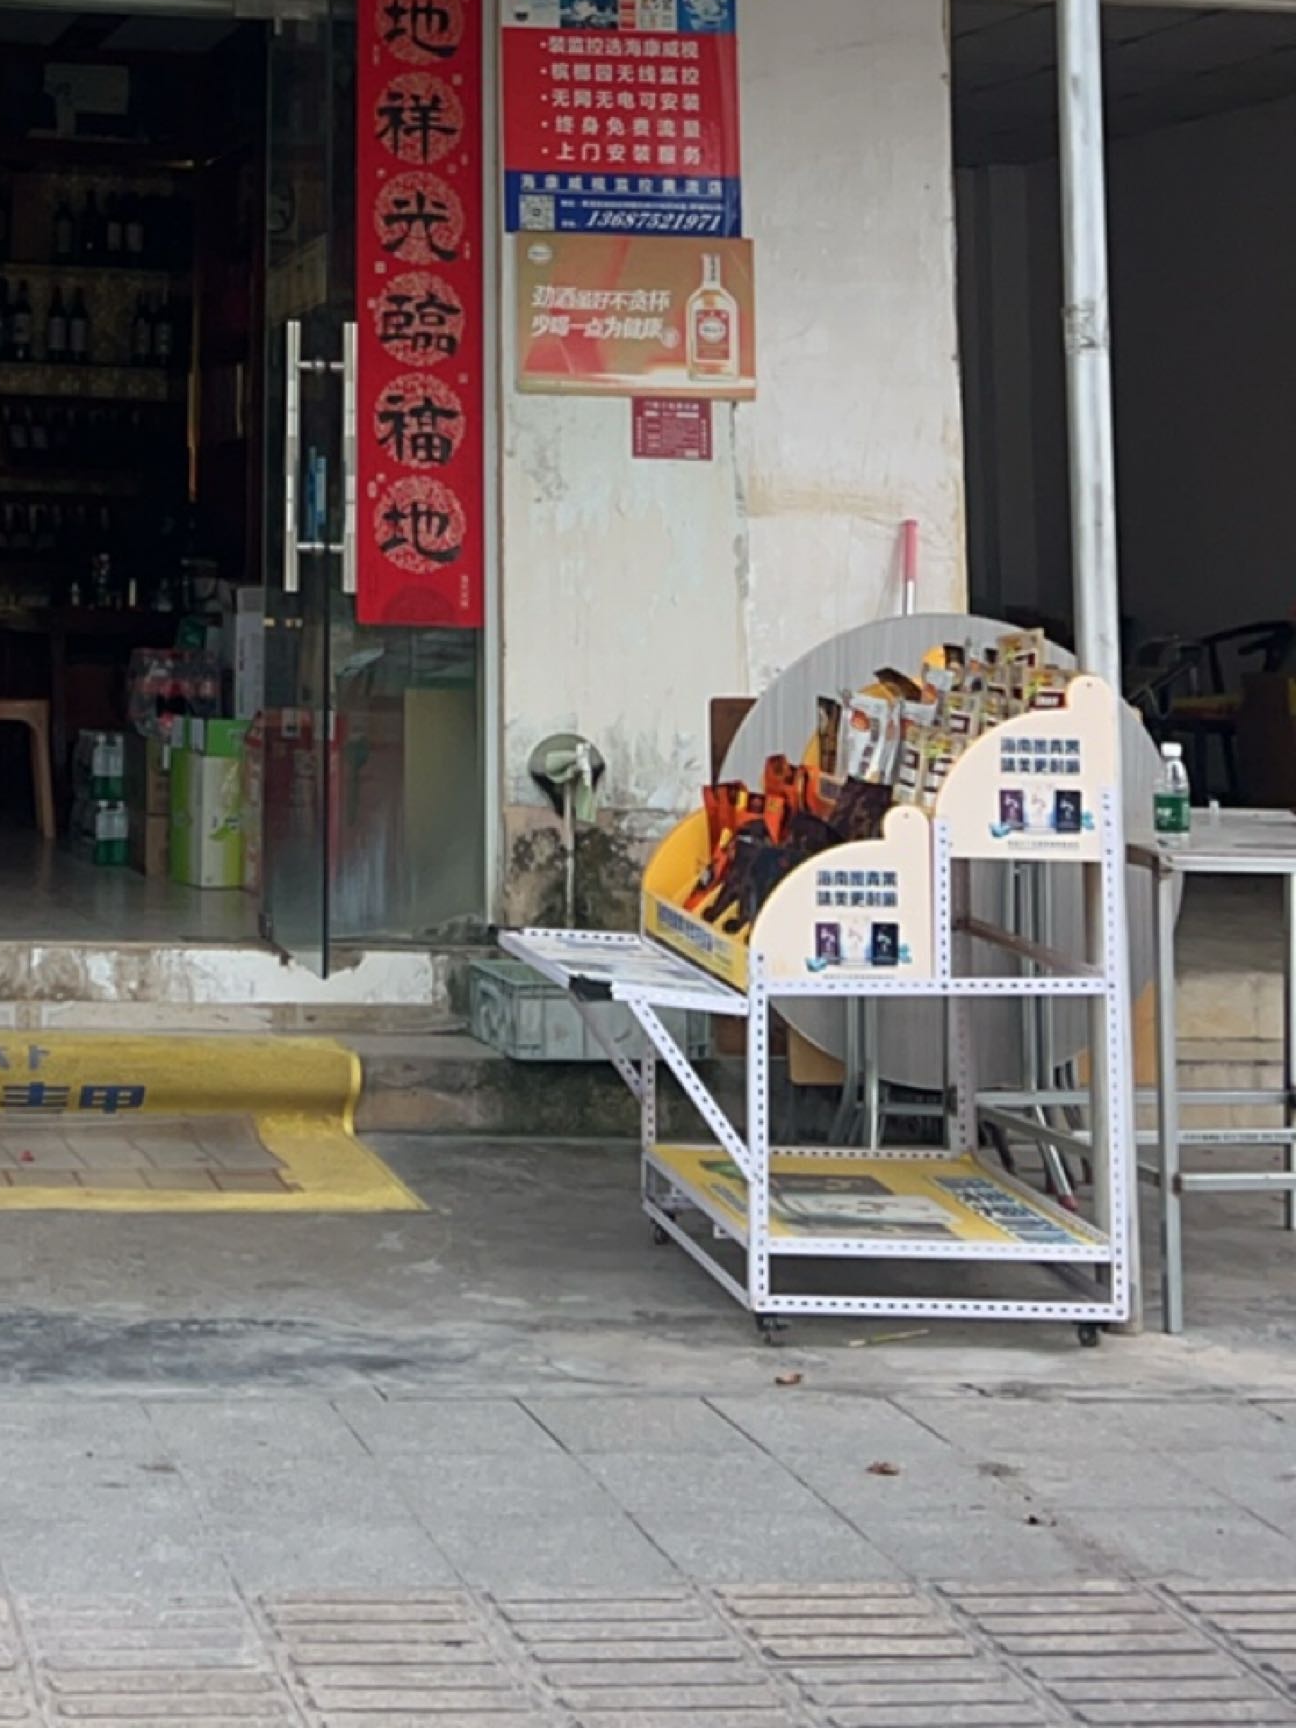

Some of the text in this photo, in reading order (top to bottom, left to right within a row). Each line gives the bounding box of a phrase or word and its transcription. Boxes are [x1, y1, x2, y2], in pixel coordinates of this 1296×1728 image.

[555, 140, 702, 166] 上门安装服务
